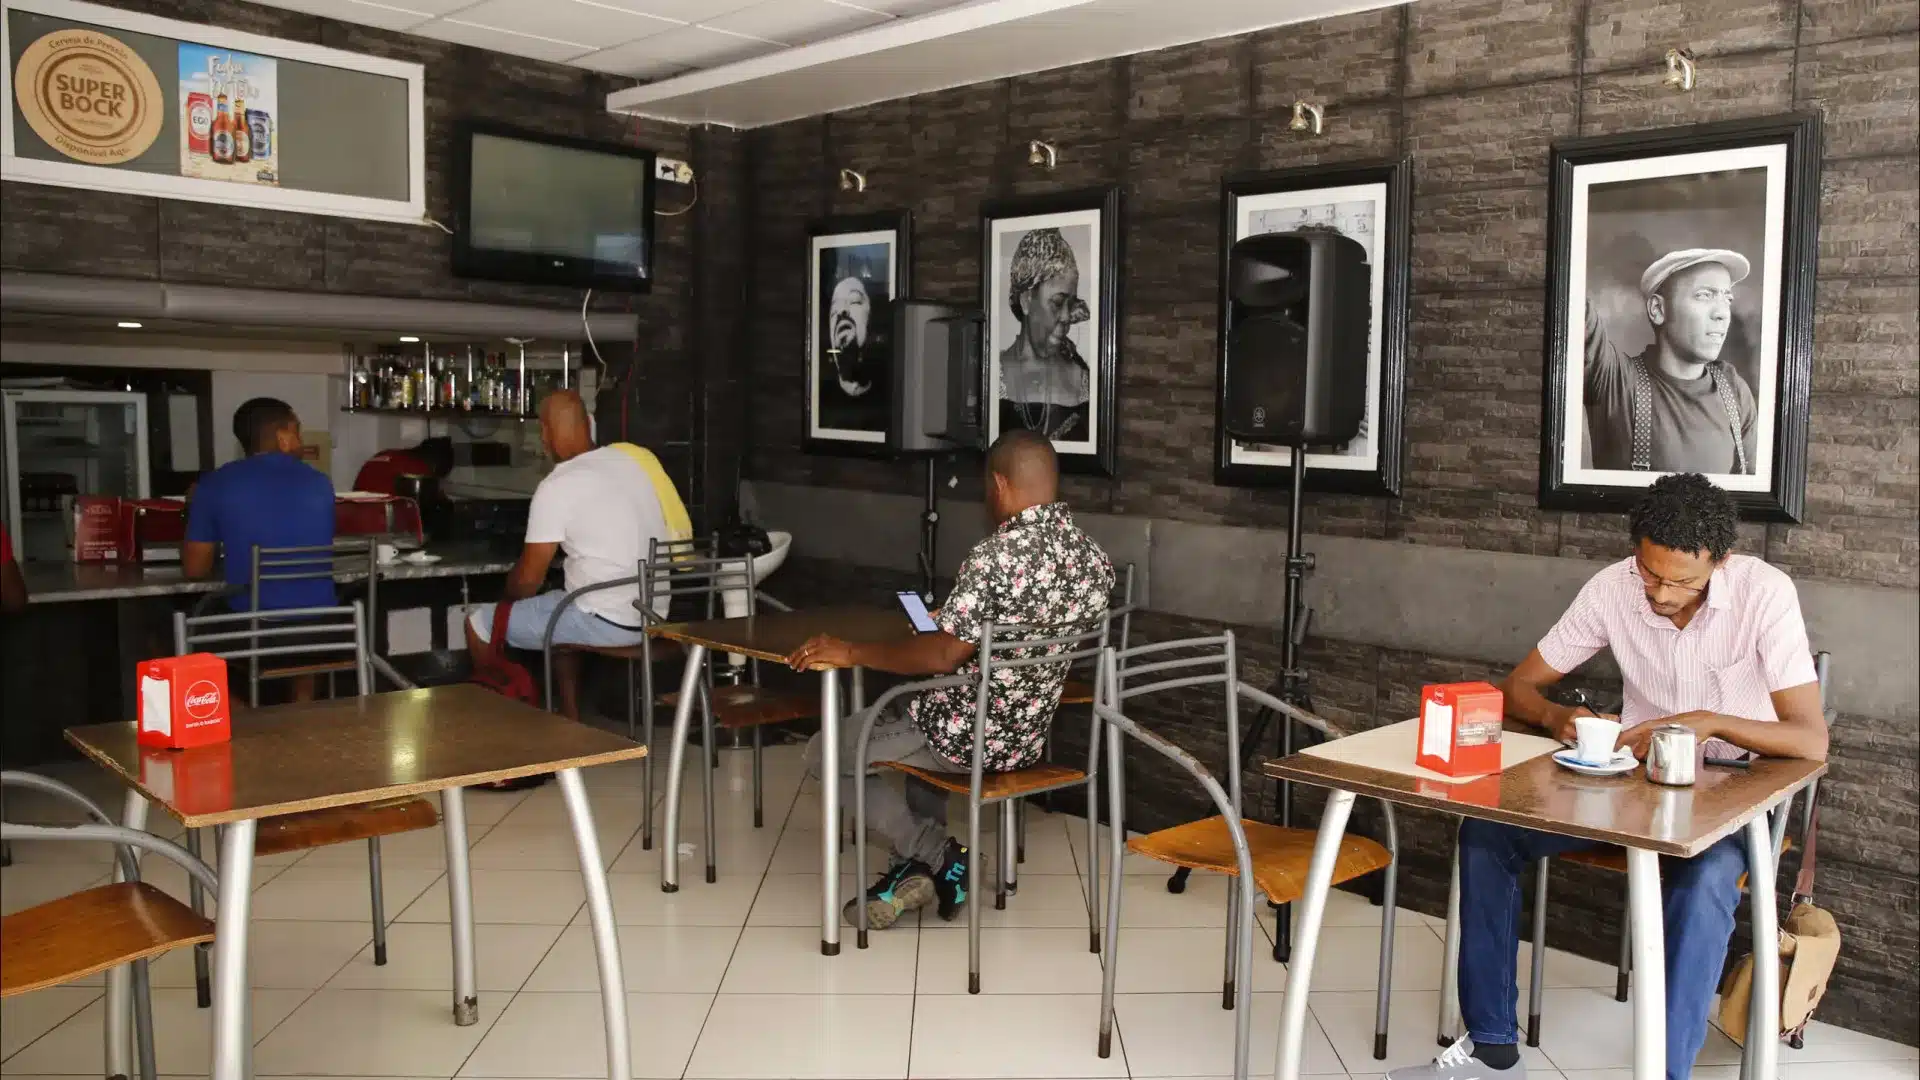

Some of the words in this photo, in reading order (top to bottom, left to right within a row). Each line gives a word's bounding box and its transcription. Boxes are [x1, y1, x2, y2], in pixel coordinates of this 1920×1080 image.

[48, 37, 82, 49] Cerveja
[83, 36, 94, 44] de
[56, 74, 126, 101] SUPER
[61, 92, 123, 118] BOCK
[54, 134, 107, 157] Disponível
[186, 692, 219, 708] Coca-Cola
